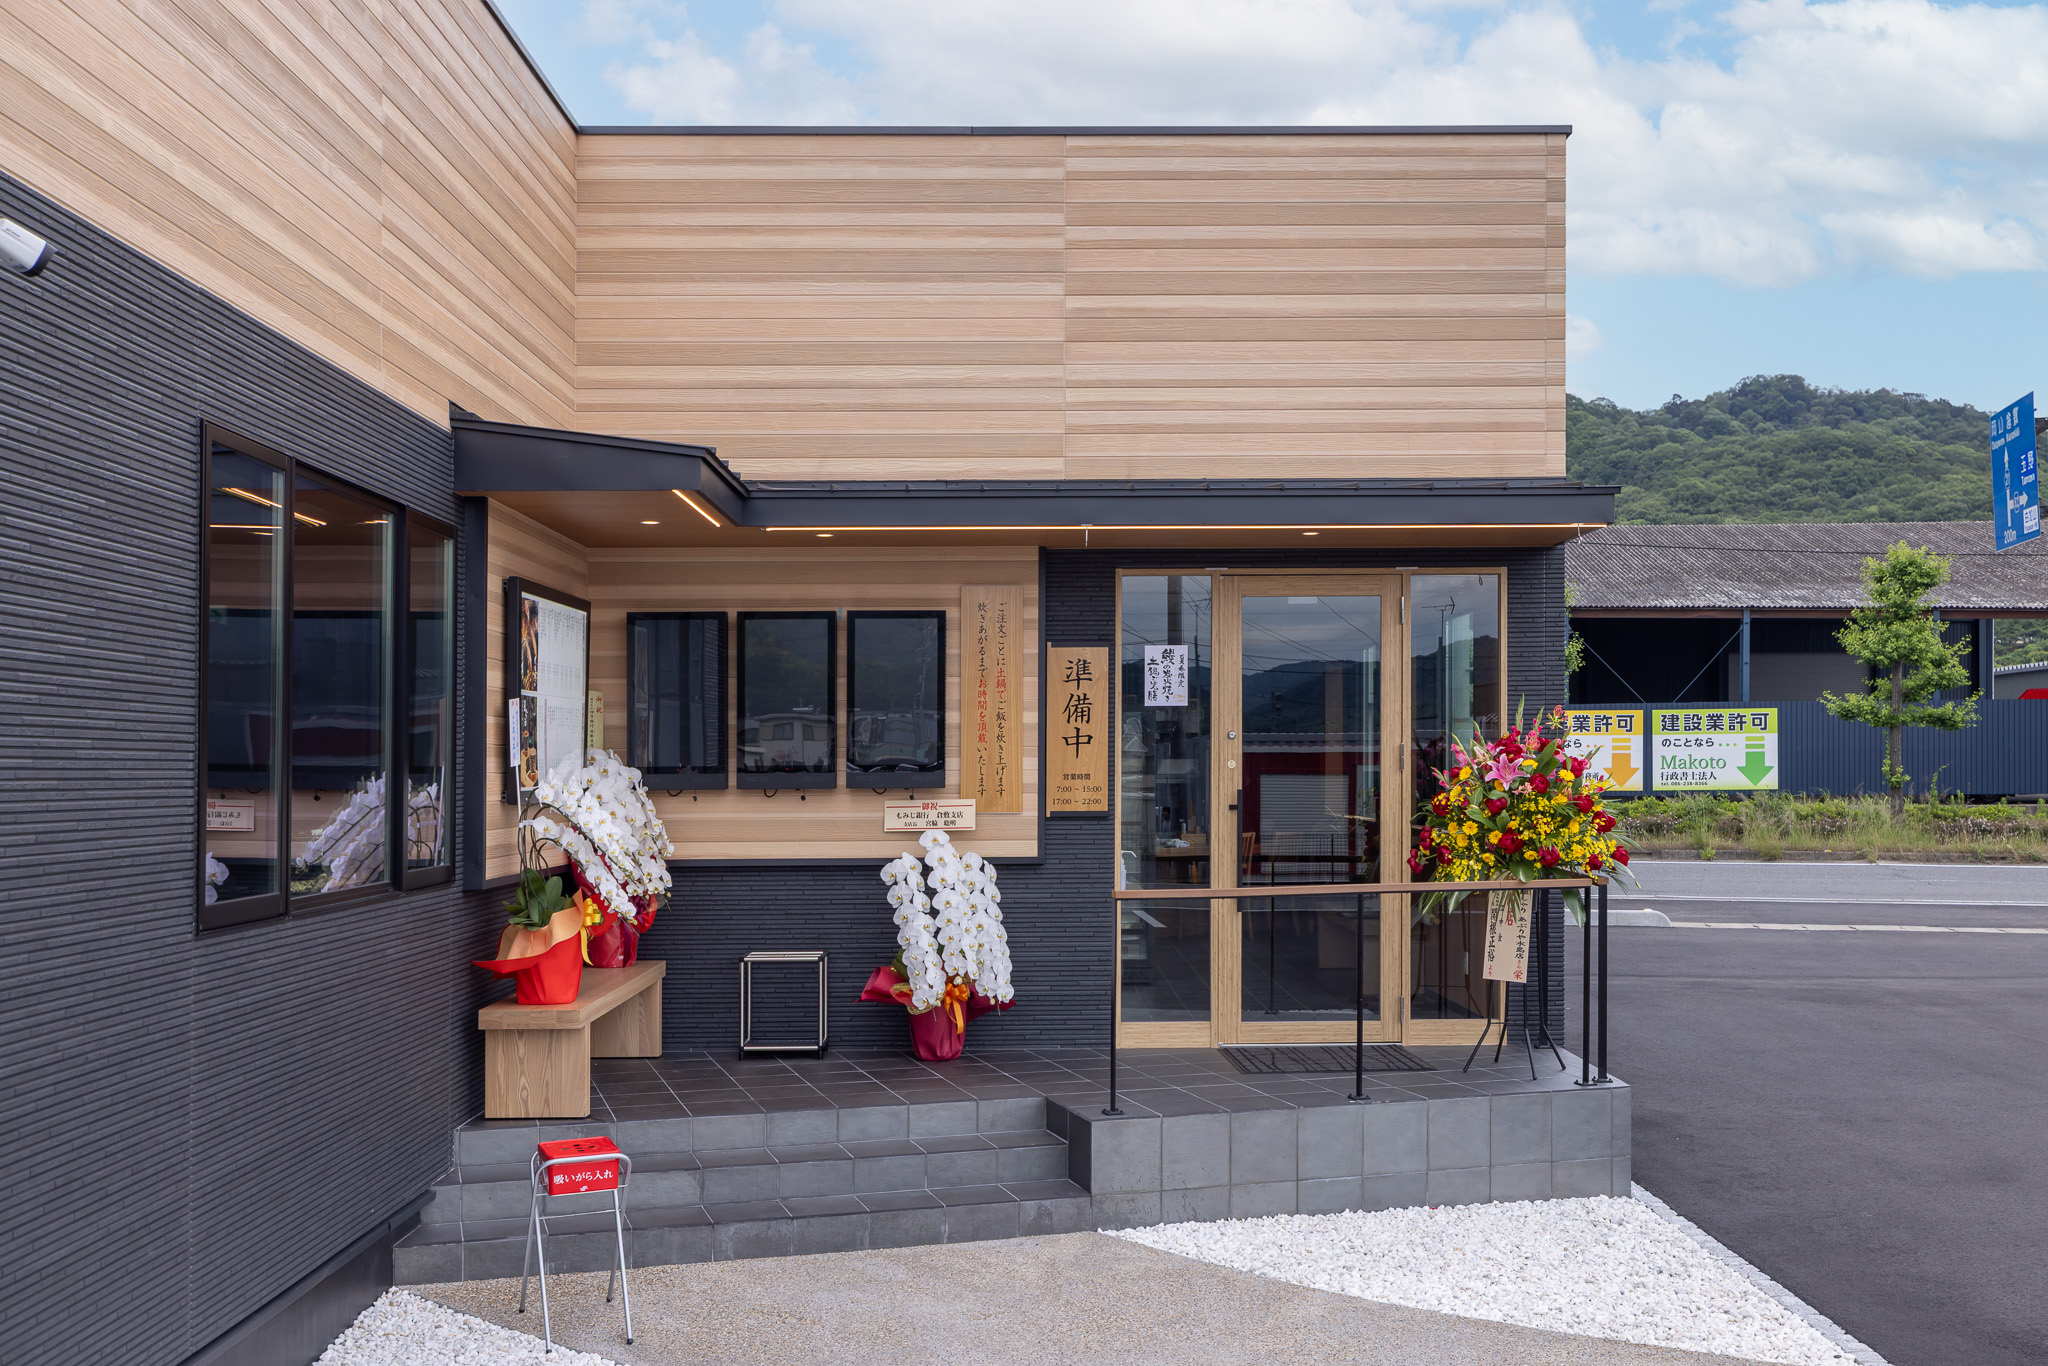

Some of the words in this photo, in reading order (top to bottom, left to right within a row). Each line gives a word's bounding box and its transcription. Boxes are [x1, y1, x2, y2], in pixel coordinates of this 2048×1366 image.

[2004, 528, 2017, 544] 200m
[977, 602, 988, 798] 炊きあがるまでお時間を頂戴いたします
[995, 602, 1007, 798] ご注文ごとに土鍋でご飯を炊き上げます
[1062, 658, 1094, 759] 準備中
[1563, 714, 1635, 733] 業許可
[1660, 712, 1770, 732] 建設業許可
[1661, 737, 1714, 748] のことなら
[1660, 754, 1727, 770] Makoto
[1062, 773, 1091, 781] 営業時間
[1660, 771, 1717, 781] 行政書士法人
[1056, 785, 1072, 793] 7:00
[1082, 785, 1102, 793] 15:00
[921, 802, 938, 811] 御祝
[1052, 797, 1072, 805] 17:00
[1082, 797, 1102, 805] 22:00
[896, 811, 930, 819] もみじ銀行
[936, 811, 964, 819] 倉敷支店
[553, 1169, 613, 1185] 吸いがら入れ
